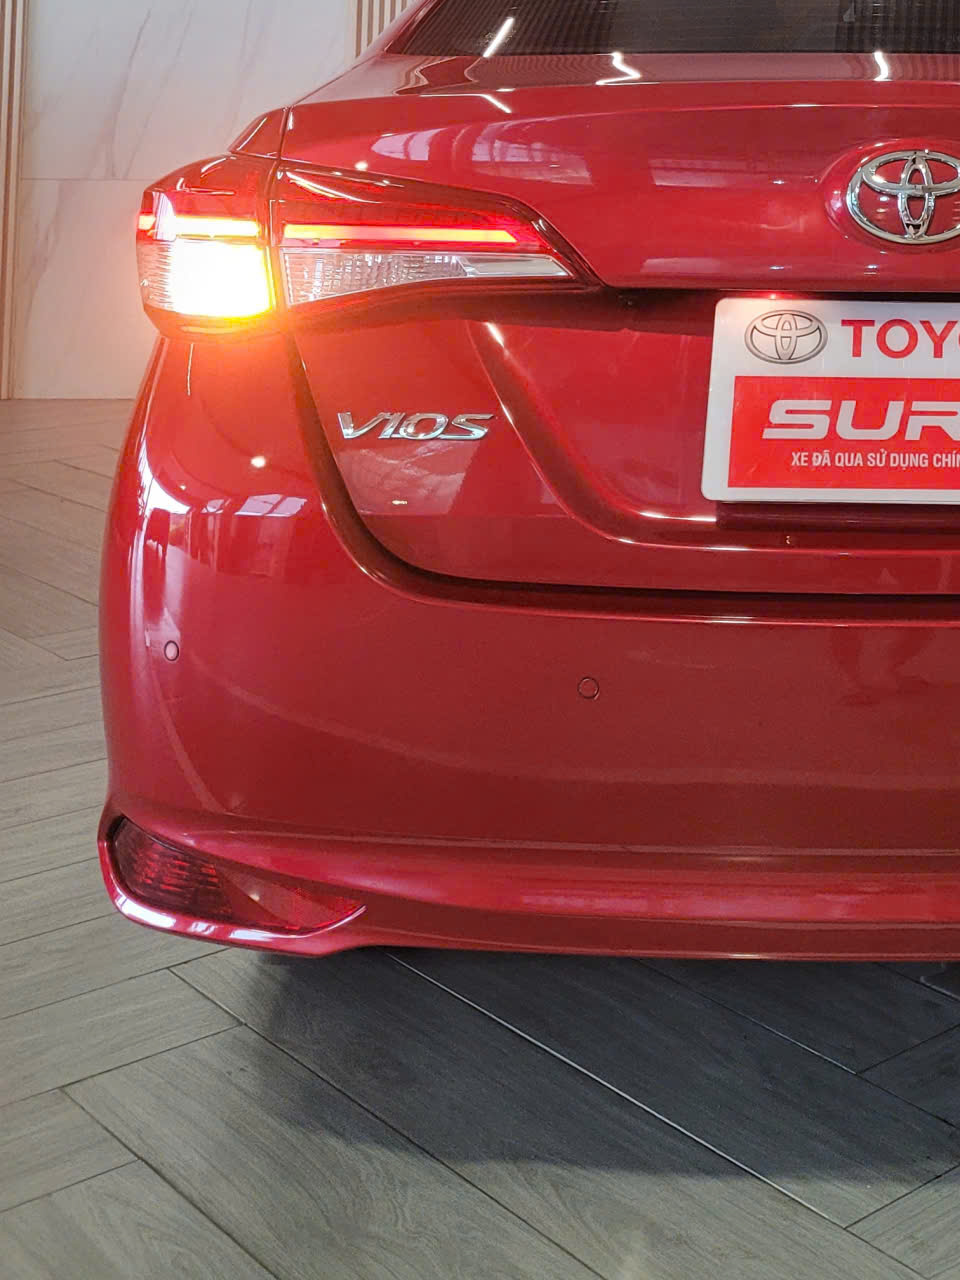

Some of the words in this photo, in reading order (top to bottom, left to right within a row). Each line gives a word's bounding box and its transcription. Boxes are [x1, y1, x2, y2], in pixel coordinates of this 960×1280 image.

[337, 412, 495, 440] VIOS
[791, 451, 809, 467] XE
[811, 449, 832, 467] ĐÃ
[834, 452, 864, 468] QUA
[867, 448, 888, 468] SỬ
[889, 452, 929, 471] DỤNG
